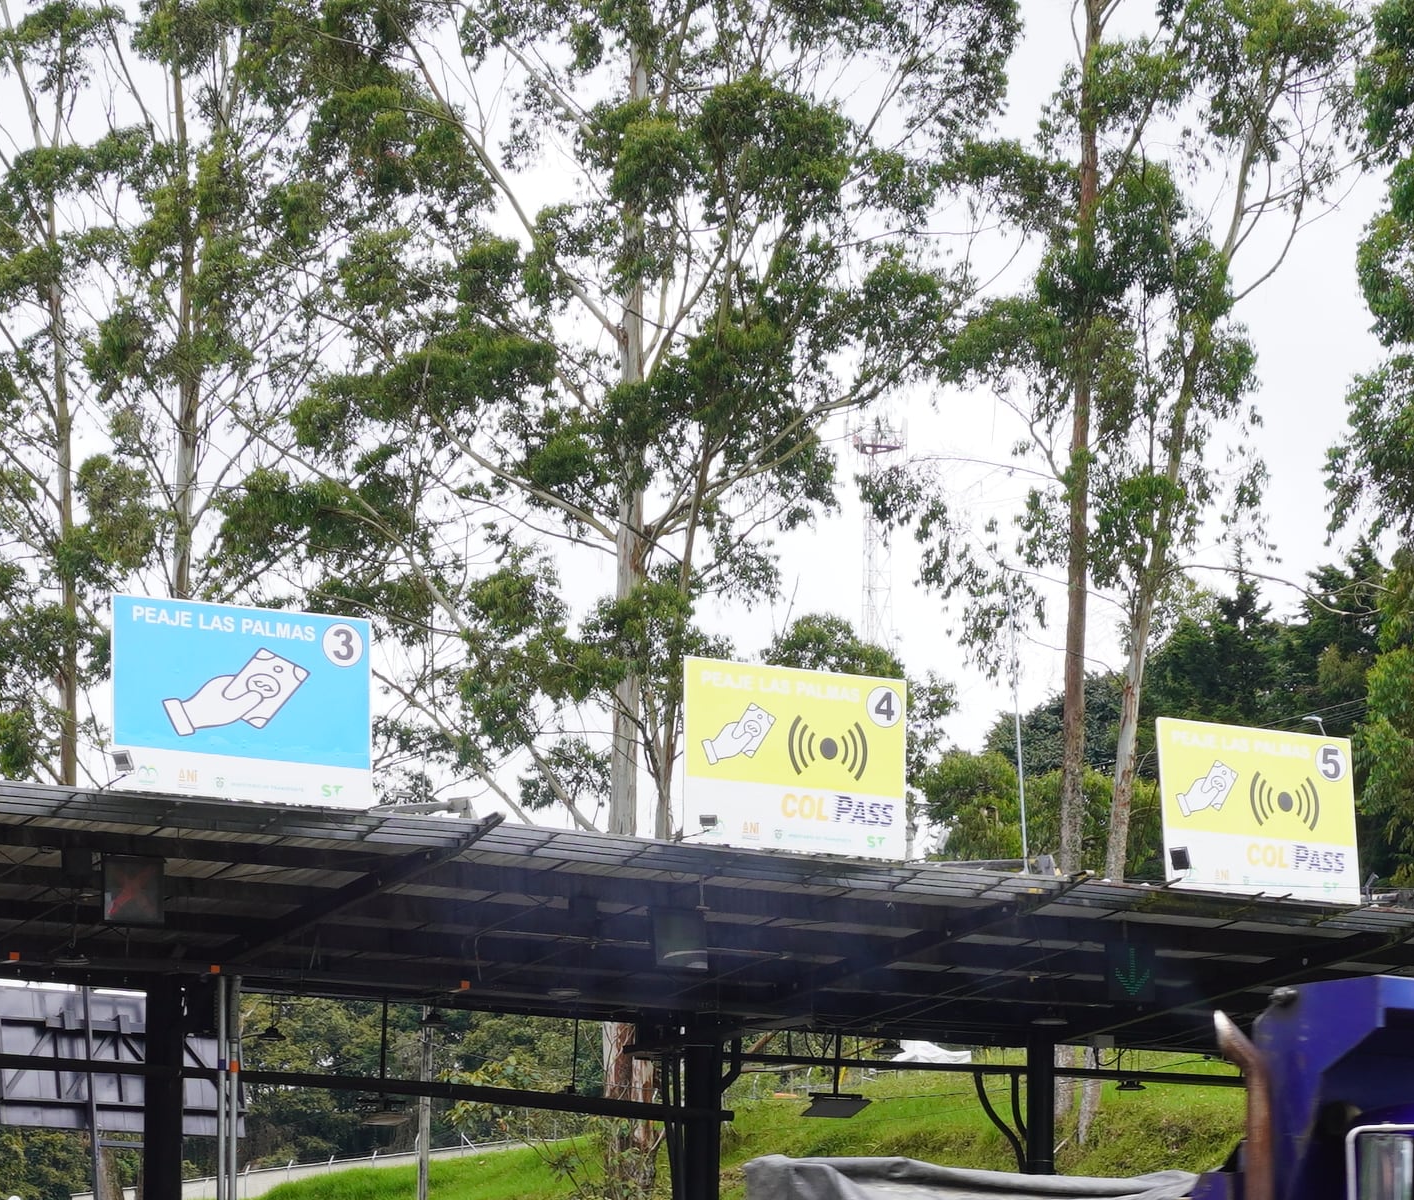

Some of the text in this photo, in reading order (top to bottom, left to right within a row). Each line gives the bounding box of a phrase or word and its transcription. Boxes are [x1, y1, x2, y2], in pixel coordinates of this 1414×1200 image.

[132, 605, 316, 642] PEAJE LAS PALMAS
[332, 628, 354, 661] 3
[701, 670, 860, 703] PEAJE LAS PALMAS
[874, 691, 895, 721] 4
[1171, 731, 1311, 760] PEAJE LAS PALMAS
[1322, 748, 1341, 779] 5
